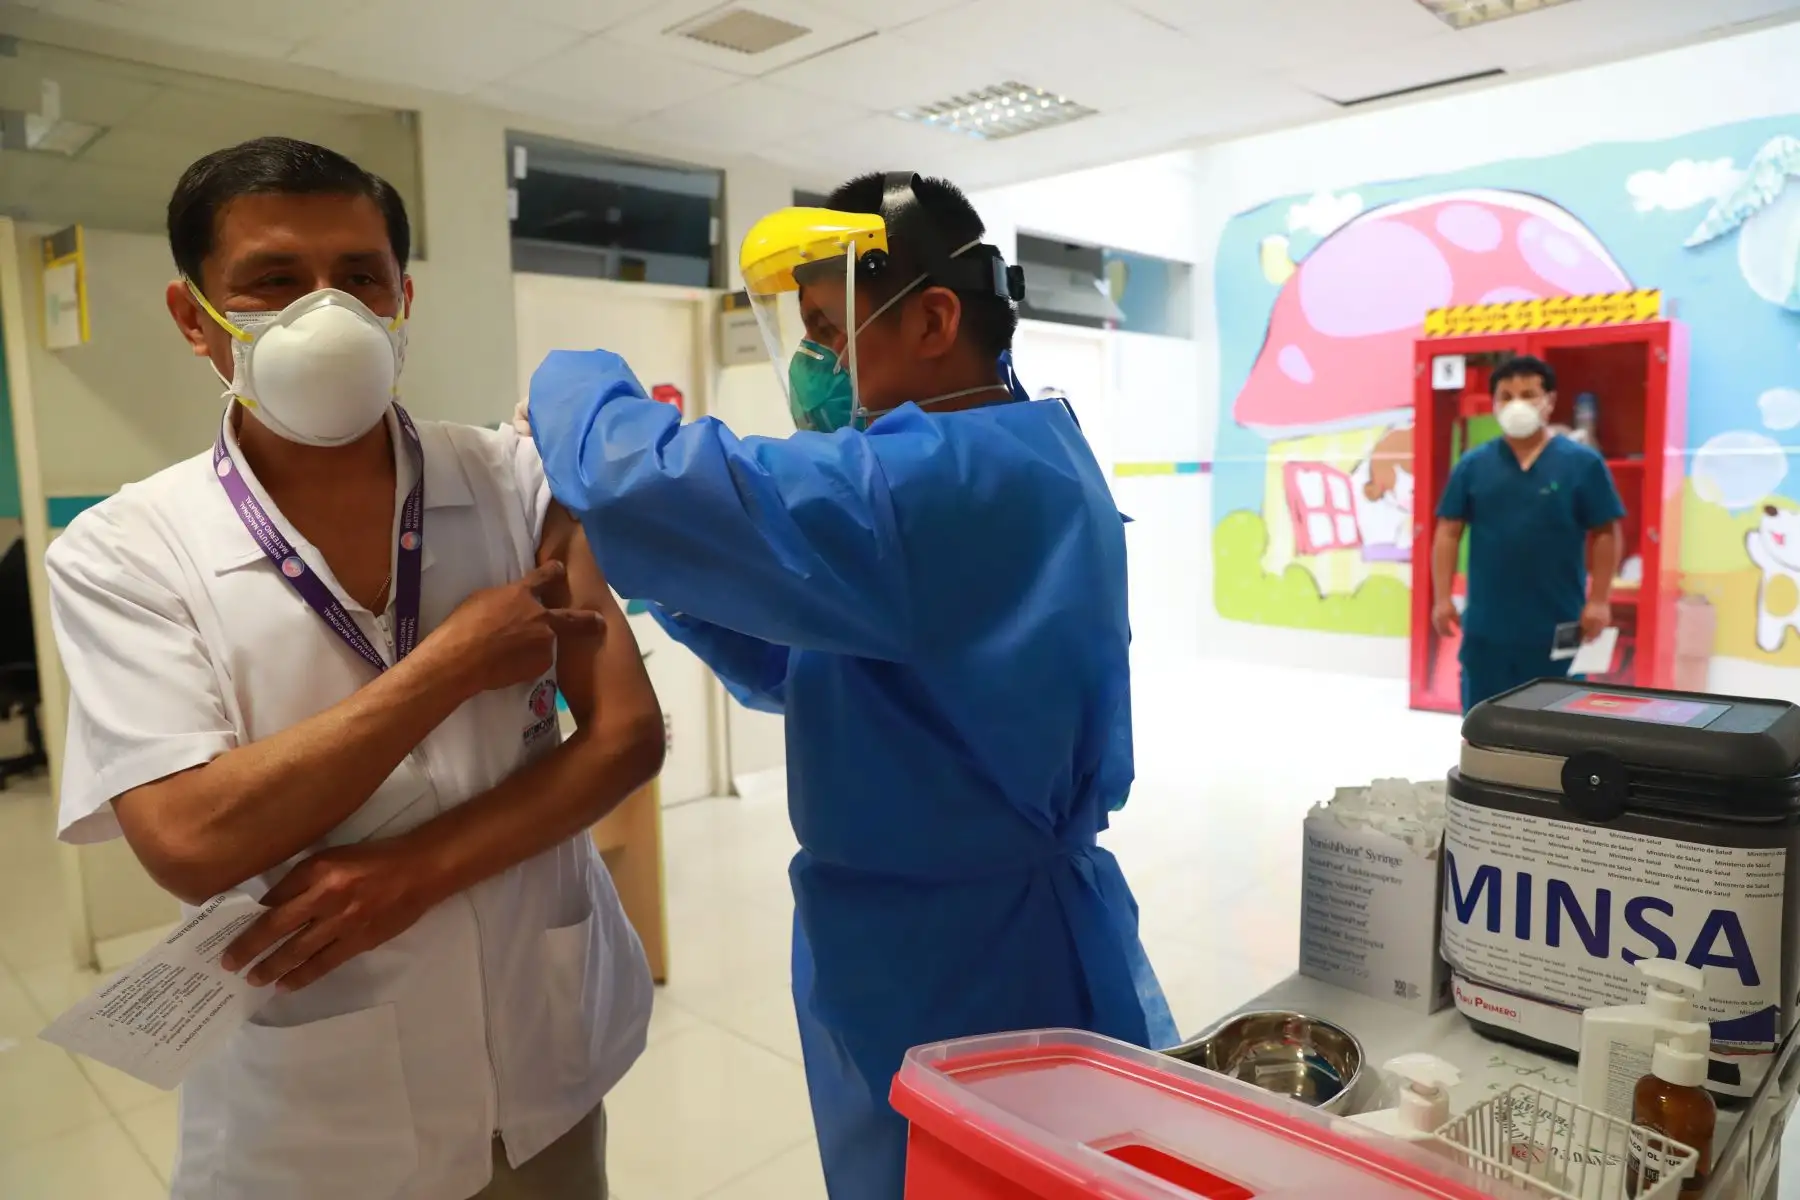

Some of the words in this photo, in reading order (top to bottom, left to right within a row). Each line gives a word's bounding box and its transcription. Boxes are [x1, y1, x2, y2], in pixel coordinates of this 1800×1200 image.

[239, 501, 260, 531] NACIONAL
[245, 495, 267, 527] PERINATAL
[257, 529, 282, 560] INSTITUTO
[264, 525, 289, 555] MATERNO
[323, 607, 351, 639] NACIONAL
[330, 601, 357, 636] PERINATAL
[1647, 850, 1675, 859] Ministerio
[1676, 843, 1705, 852] Ministerio
[1365, 848, 1403, 868] Syringe
[1674, 863, 1704, 872] Ministerio
[1715, 860, 1745, 868] Ministerio
[1645, 869, 1674, 879] Ministerio
[1674, 884, 1703, 893] Ministerio
[1715, 881, 1744, 889] Ministerio
[197, 912, 208, 921] DE
[205, 895, 226, 914] SALUD
[1443, 848, 1760, 986] MINSA
[1709, 997, 1739, 1005] Ministerio
